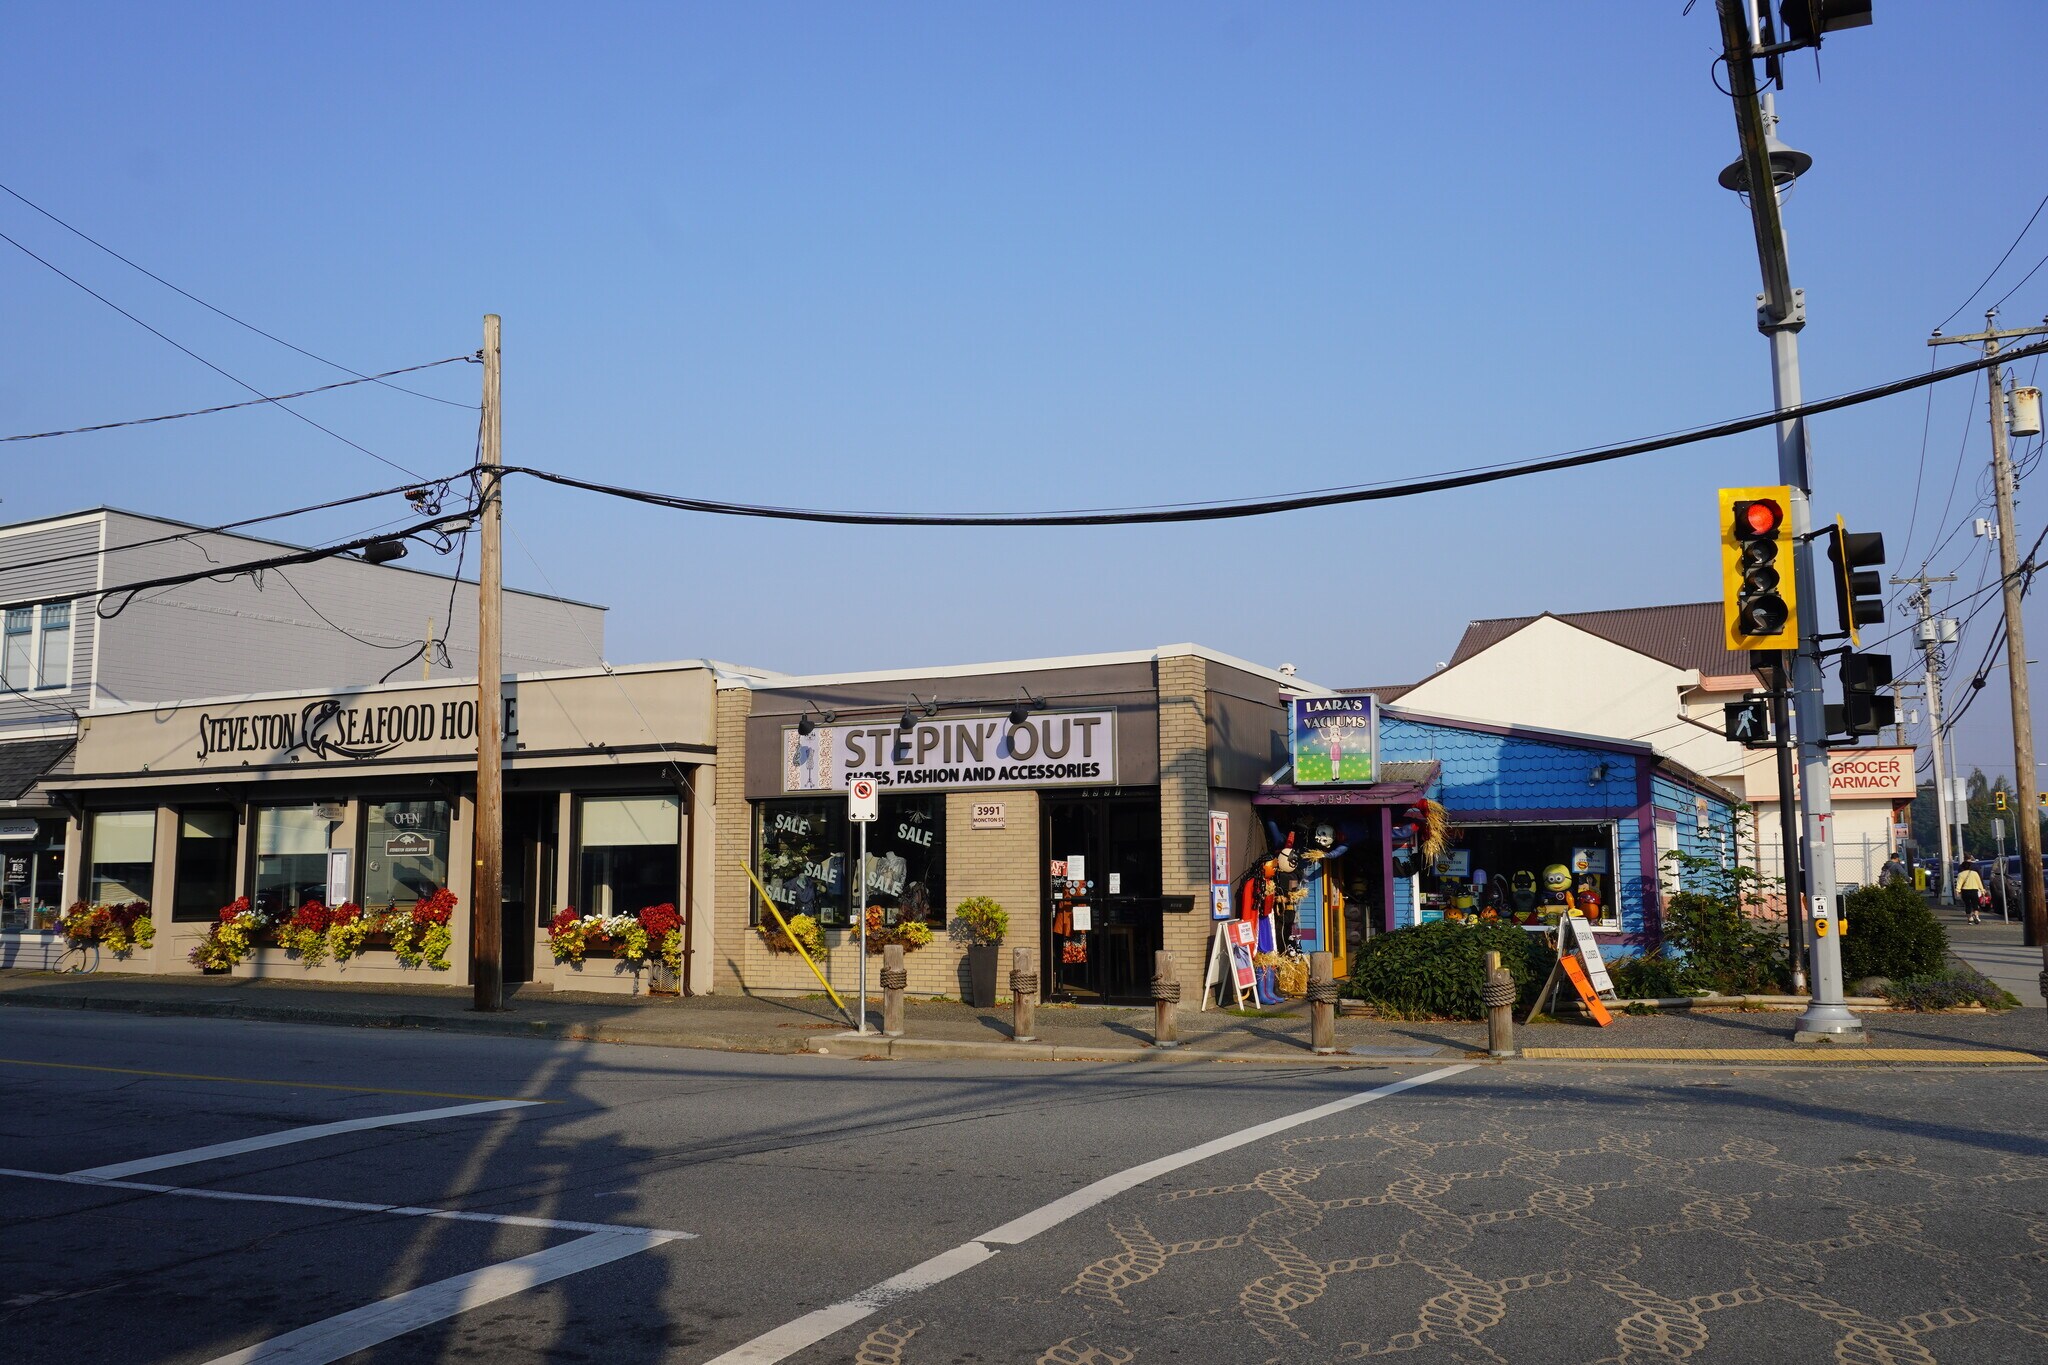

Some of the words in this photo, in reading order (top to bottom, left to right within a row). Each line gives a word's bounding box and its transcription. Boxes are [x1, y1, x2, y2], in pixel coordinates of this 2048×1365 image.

[1306, 700, 1363, 713] LAARA'S
[197, 713, 297, 759] STEVESTON
[334, 703, 435, 747] SEAFOOD
[440, 695, 519, 740] HOE
[1304, 716, 1366, 729] VACUUMS
[845, 722, 998, 768] STEPIN'
[1007, 716, 1101, 761] OUT
[897, 768, 960, 785] FASHION
[962, 766, 995, 782] AND
[999, 762, 1100, 781] ACCESSORIES
[1832, 760, 1901, 775] GROCER
[1828, 775, 1901, 789] ARMACY
[394, 812, 420, 825] OPEN
[977, 806, 1000, 816] 3991
[774, 814, 808, 836] SALE
[897, 823, 933, 847] SALE
[804, 861, 838, 884] SALE
[766, 884, 797, 905] SALE
[867, 871, 900, 897] SALE
